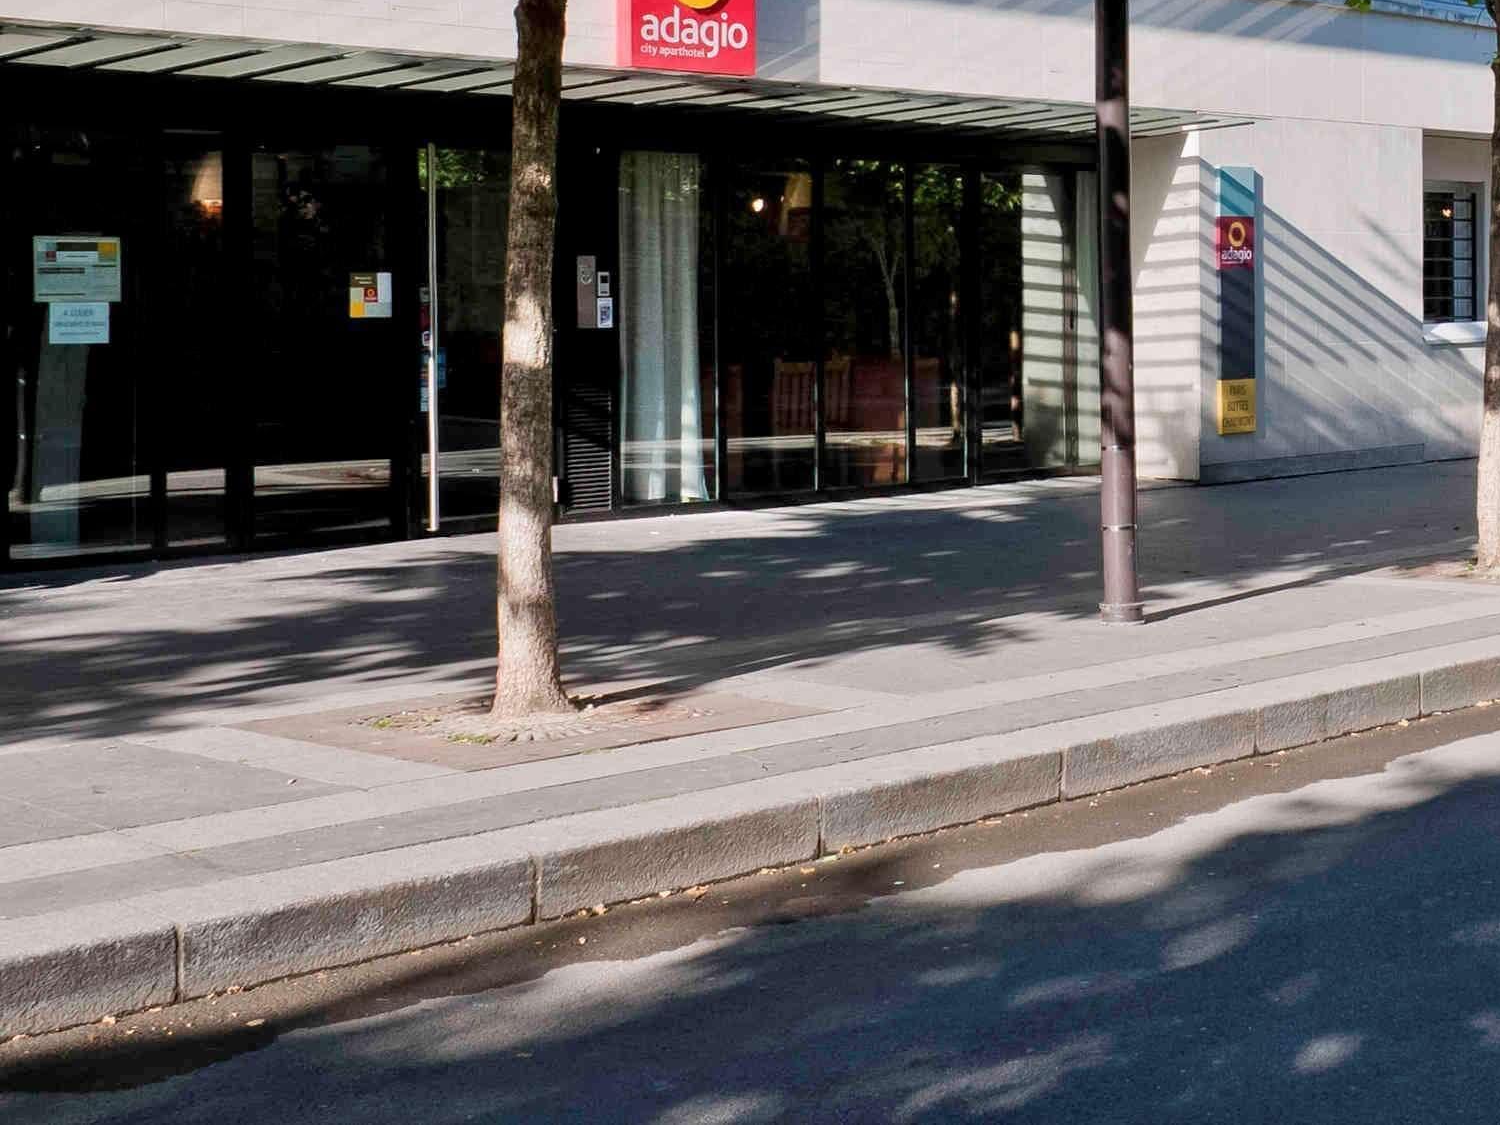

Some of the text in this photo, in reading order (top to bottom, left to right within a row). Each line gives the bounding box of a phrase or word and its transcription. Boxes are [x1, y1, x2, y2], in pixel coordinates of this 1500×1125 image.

[640, 5, 748, 59] adagio
[640, 43, 705, 59] city aparthotel
[1221, 246, 1252, 264] adagio
